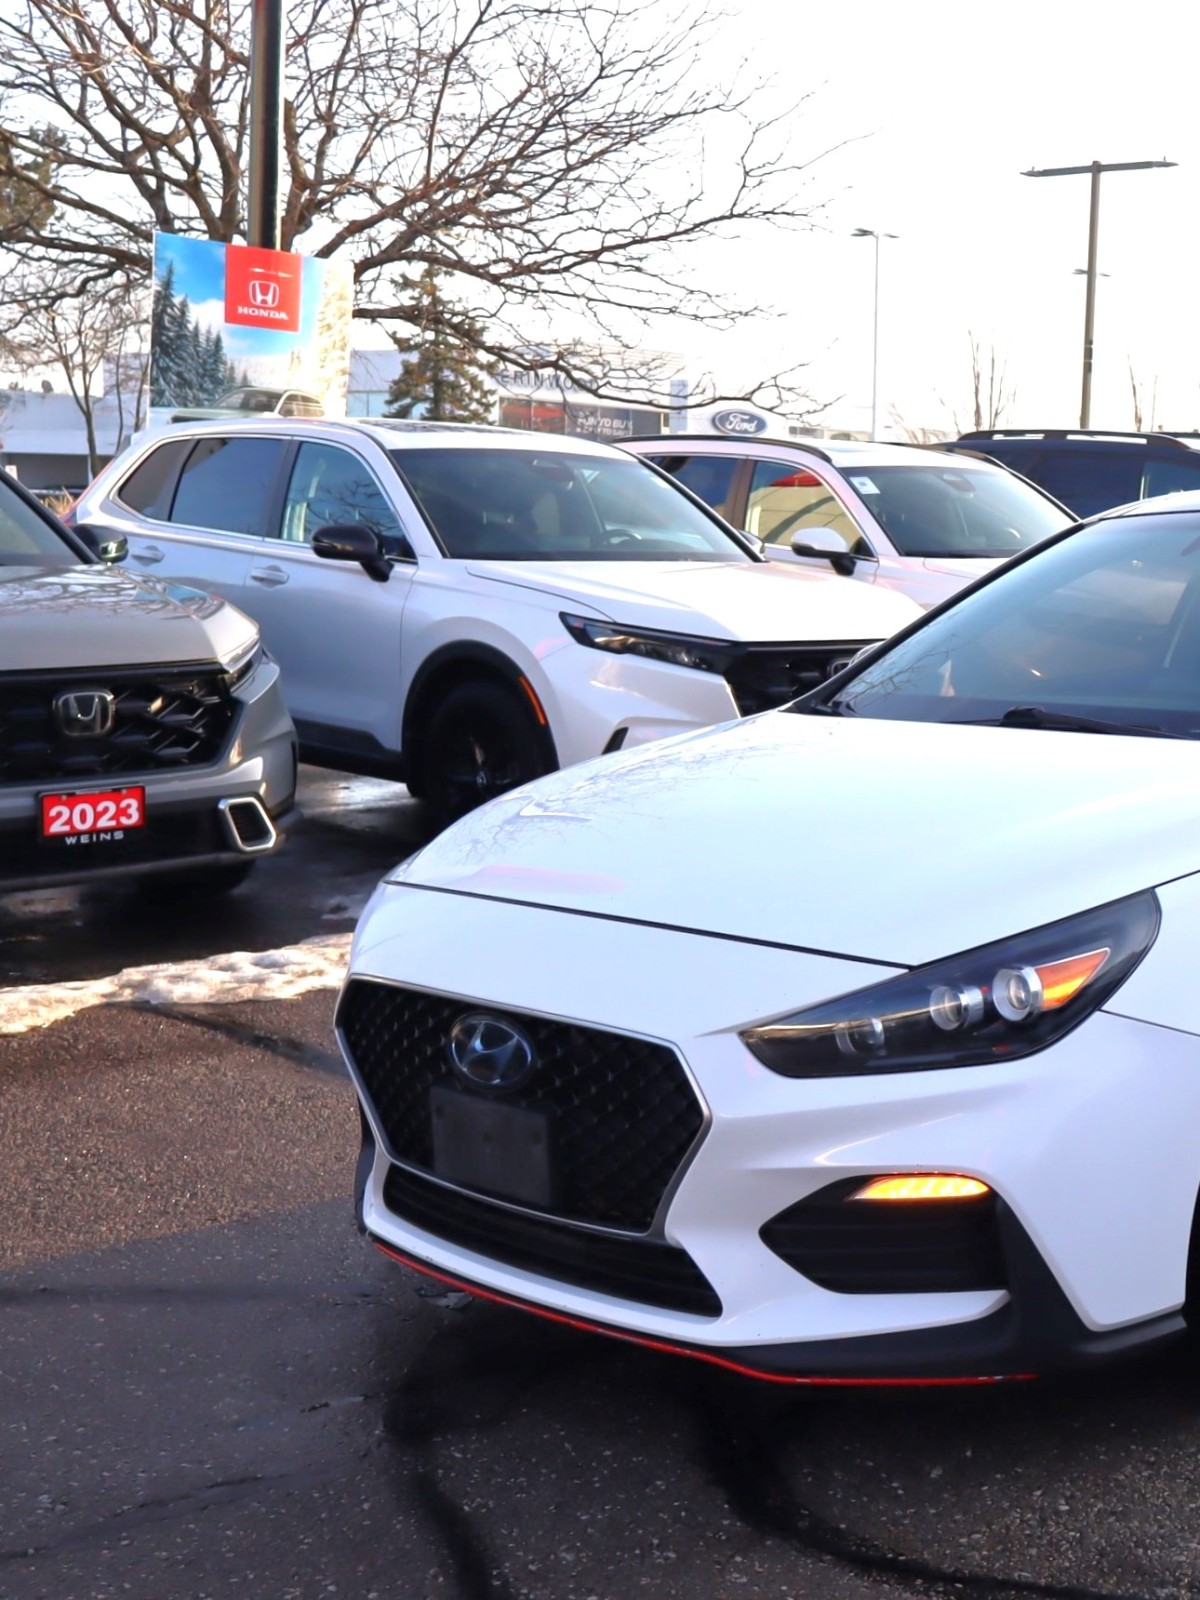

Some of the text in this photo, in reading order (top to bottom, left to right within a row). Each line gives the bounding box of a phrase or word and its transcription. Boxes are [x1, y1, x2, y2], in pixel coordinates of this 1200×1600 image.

[237, 305, 289, 320] HONDA
[500, 369, 599, 391] ERINWOD
[725, 412, 758, 432] Ford
[48, 798, 140, 833] 2023
[64, 830, 125, 846] WEINS
